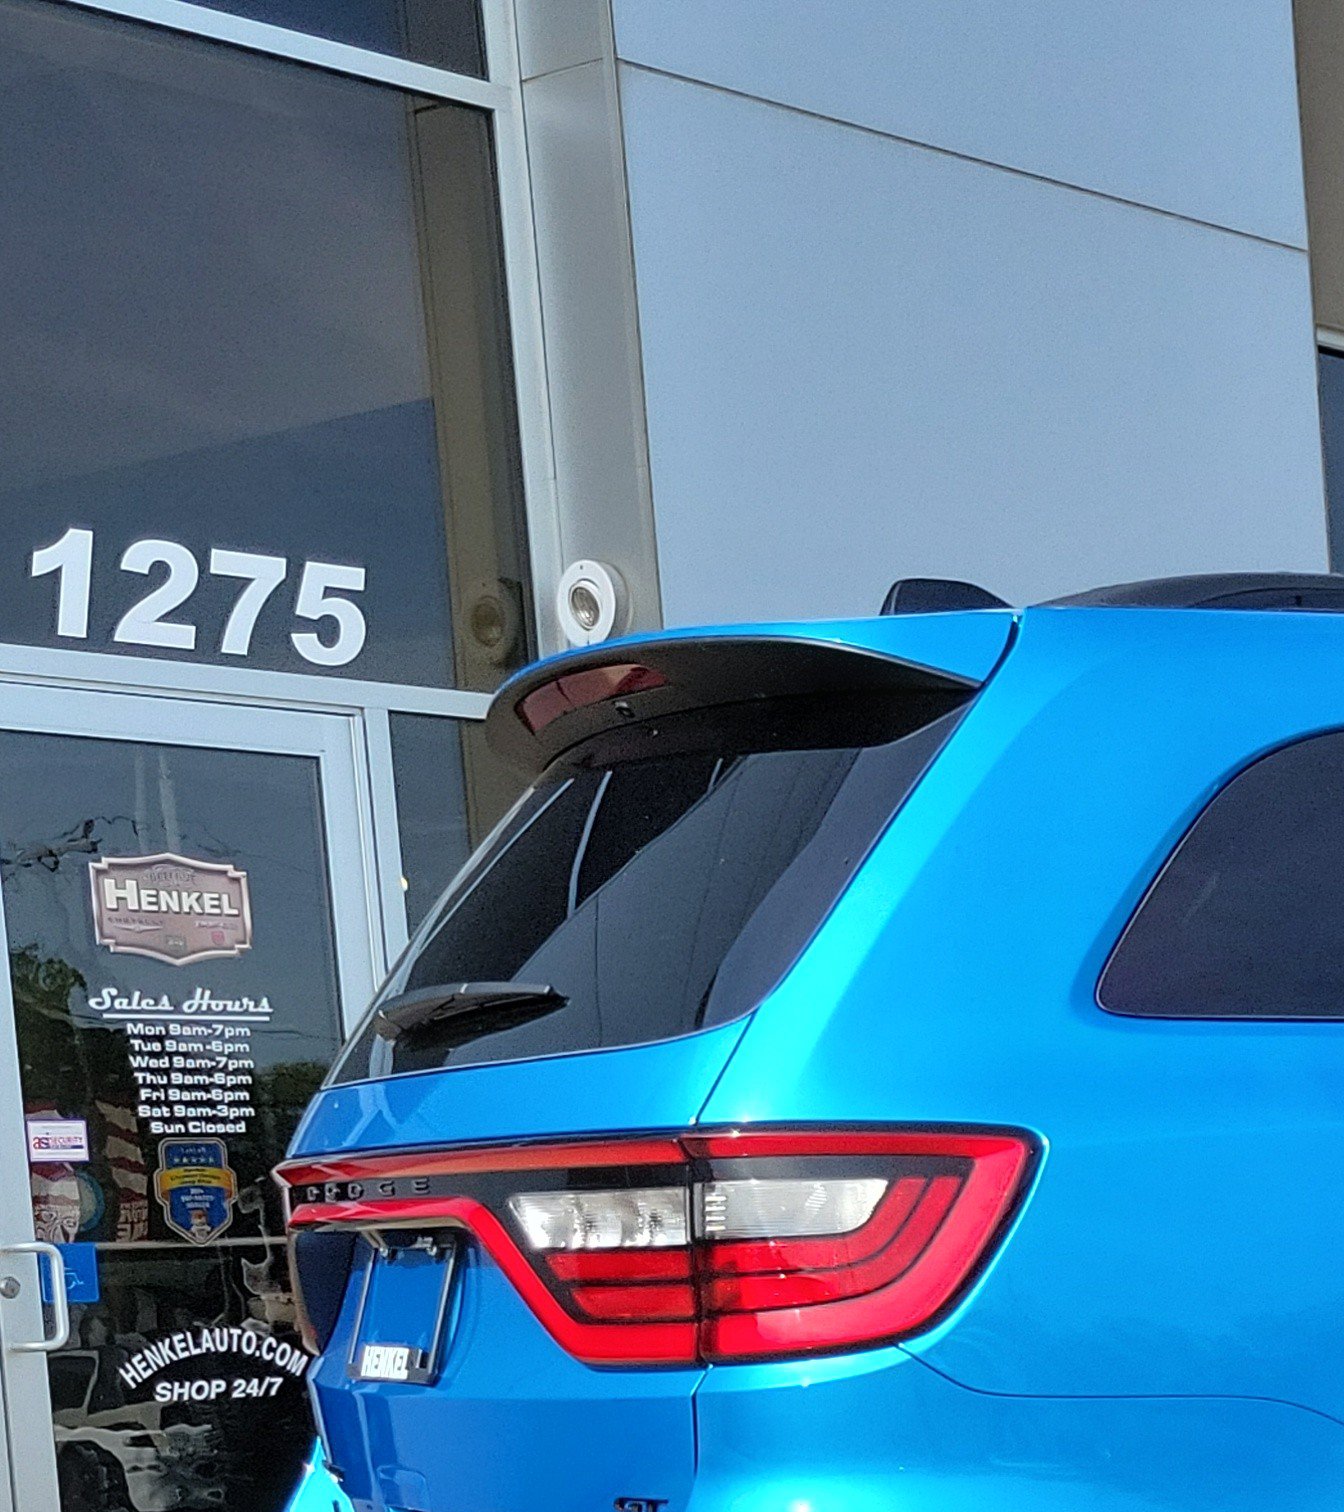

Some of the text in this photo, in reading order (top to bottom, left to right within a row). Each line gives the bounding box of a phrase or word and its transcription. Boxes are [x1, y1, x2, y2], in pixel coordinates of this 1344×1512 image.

[31, 528, 366, 666] 1275
[103, 878, 240, 916] HENKEL
[88, 987, 274, 1013] Sales Hours
[126, 1023, 251, 1038] Mon 9am-7pm
[130, 1039, 162, 1052] Tue
[128, 1055, 255, 1071] Wed 9am-7pm
[133, 1072, 168, 1085] Thu
[139, 1088, 165, 1101] Fri
[138, 1104, 255, 1119] Sat 9am-3pm
[150, 1120, 246, 1133] Sun Closed
[118, 1328, 309, 1389] HENKELAUTO.COM
[361, 1345, 410, 1380] HENKEL
[154, 1376, 284, 1402] SHOP 24/7
